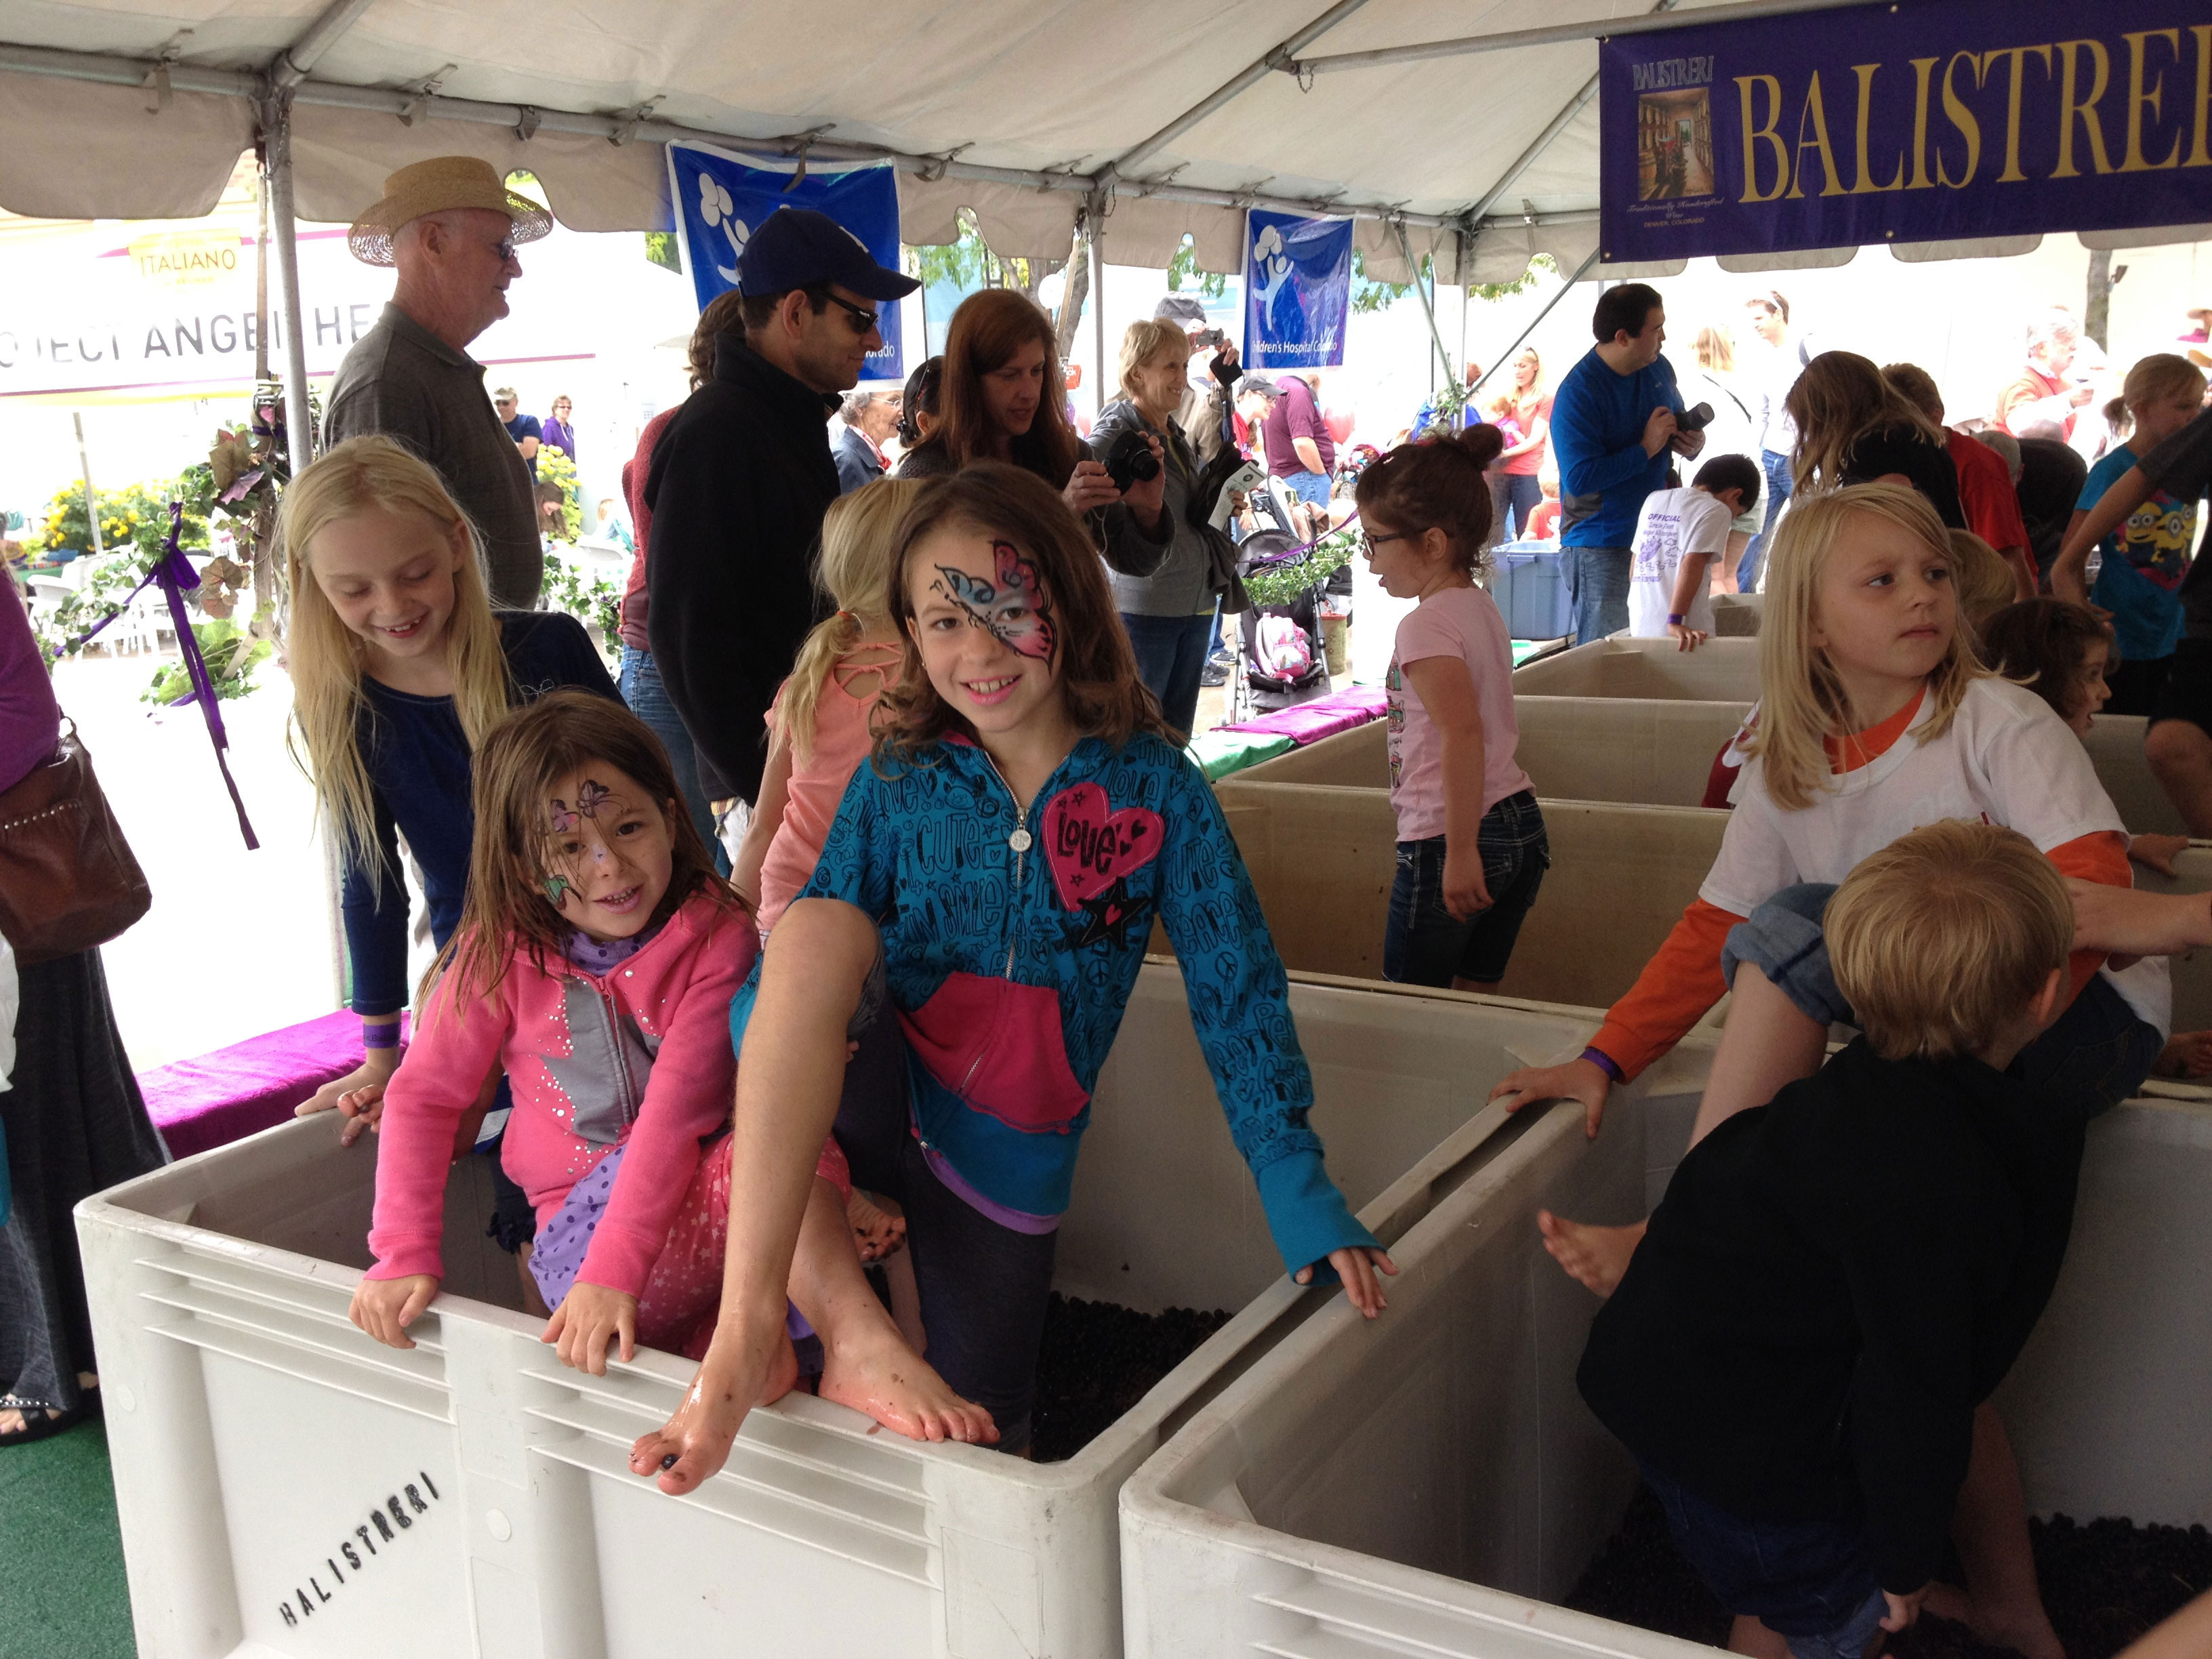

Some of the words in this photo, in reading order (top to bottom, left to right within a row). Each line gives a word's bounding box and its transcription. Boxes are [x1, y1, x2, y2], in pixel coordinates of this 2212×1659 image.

[1632, 55, 1715, 91] BALISTRERI
[140, 249, 235, 276] ITALIANO
[1284, 341, 1312, 356] Hospital
[1647, 514, 1681, 522] OFFICIAL
